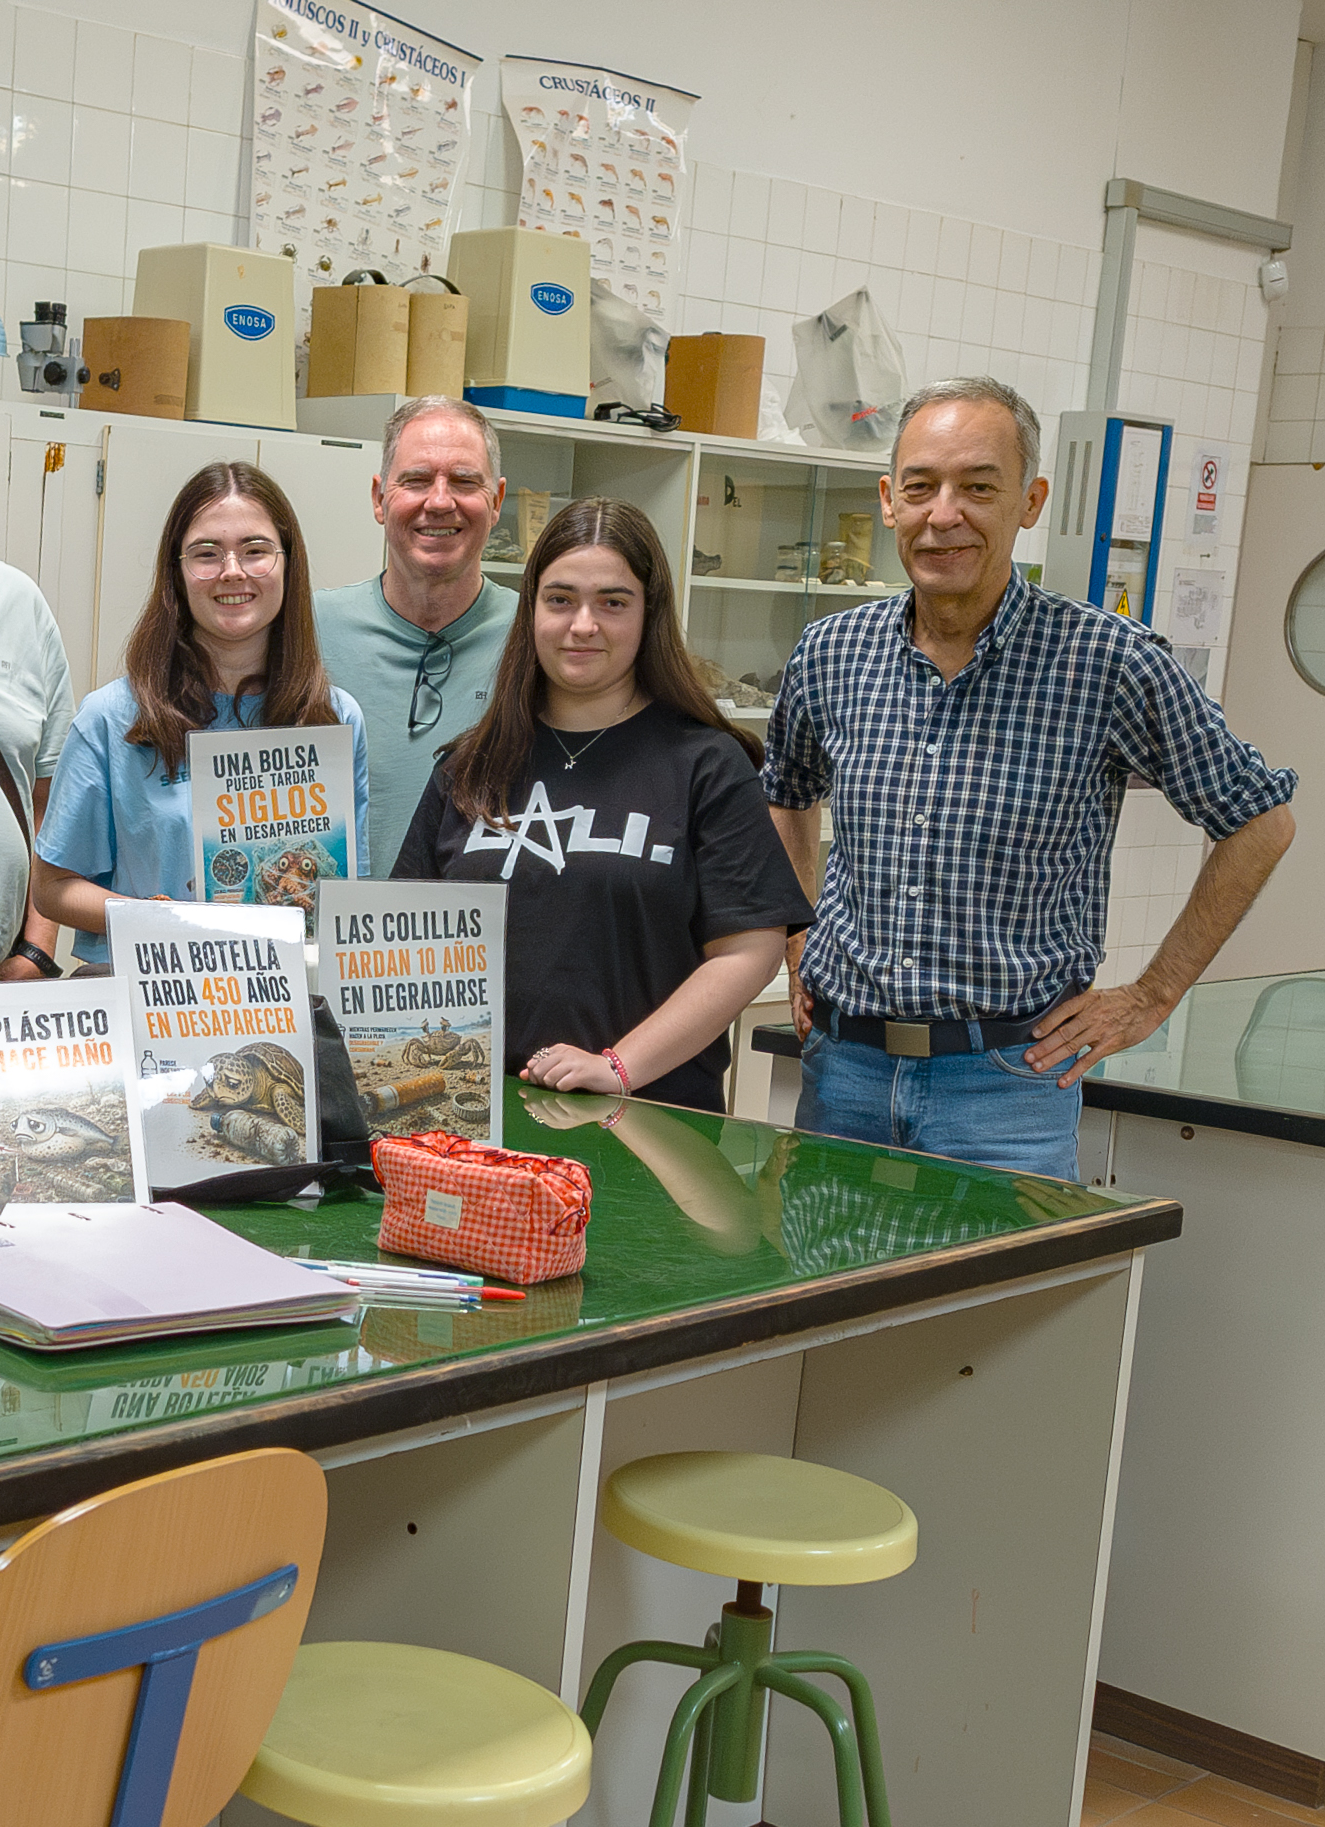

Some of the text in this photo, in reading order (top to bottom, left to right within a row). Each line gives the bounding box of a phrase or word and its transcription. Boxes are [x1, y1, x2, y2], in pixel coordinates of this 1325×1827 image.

[375, 30, 458, 84] CRUSTÁCEOS
[539, 75, 642, 110] CRUSTÁCEOS
[536, 290, 567, 304] ENOSA
[232, 313, 267, 329] ENOSA
[212, 744, 320, 778] UNA BOLSA
[226, 768, 316, 793] PUEDE TARDAR
[216, 782, 328, 828] SIGLOS
[220, 816, 331, 844] EN DESAPARECER
[335, 908, 482, 945] LAS COLILLAS
[134, 938, 282, 975] UNA BOTELLA
[336, 940, 488, 980] TARDAN 10 AÑOS
[138, 972, 292, 1007] TARDA 450 AÑOS
[340, 978, 488, 1015] EN DEGRADARSE
[146, 1006, 298, 1040] EN DESAPARECER
[56, 1037, 114, 1068] DAÑO
